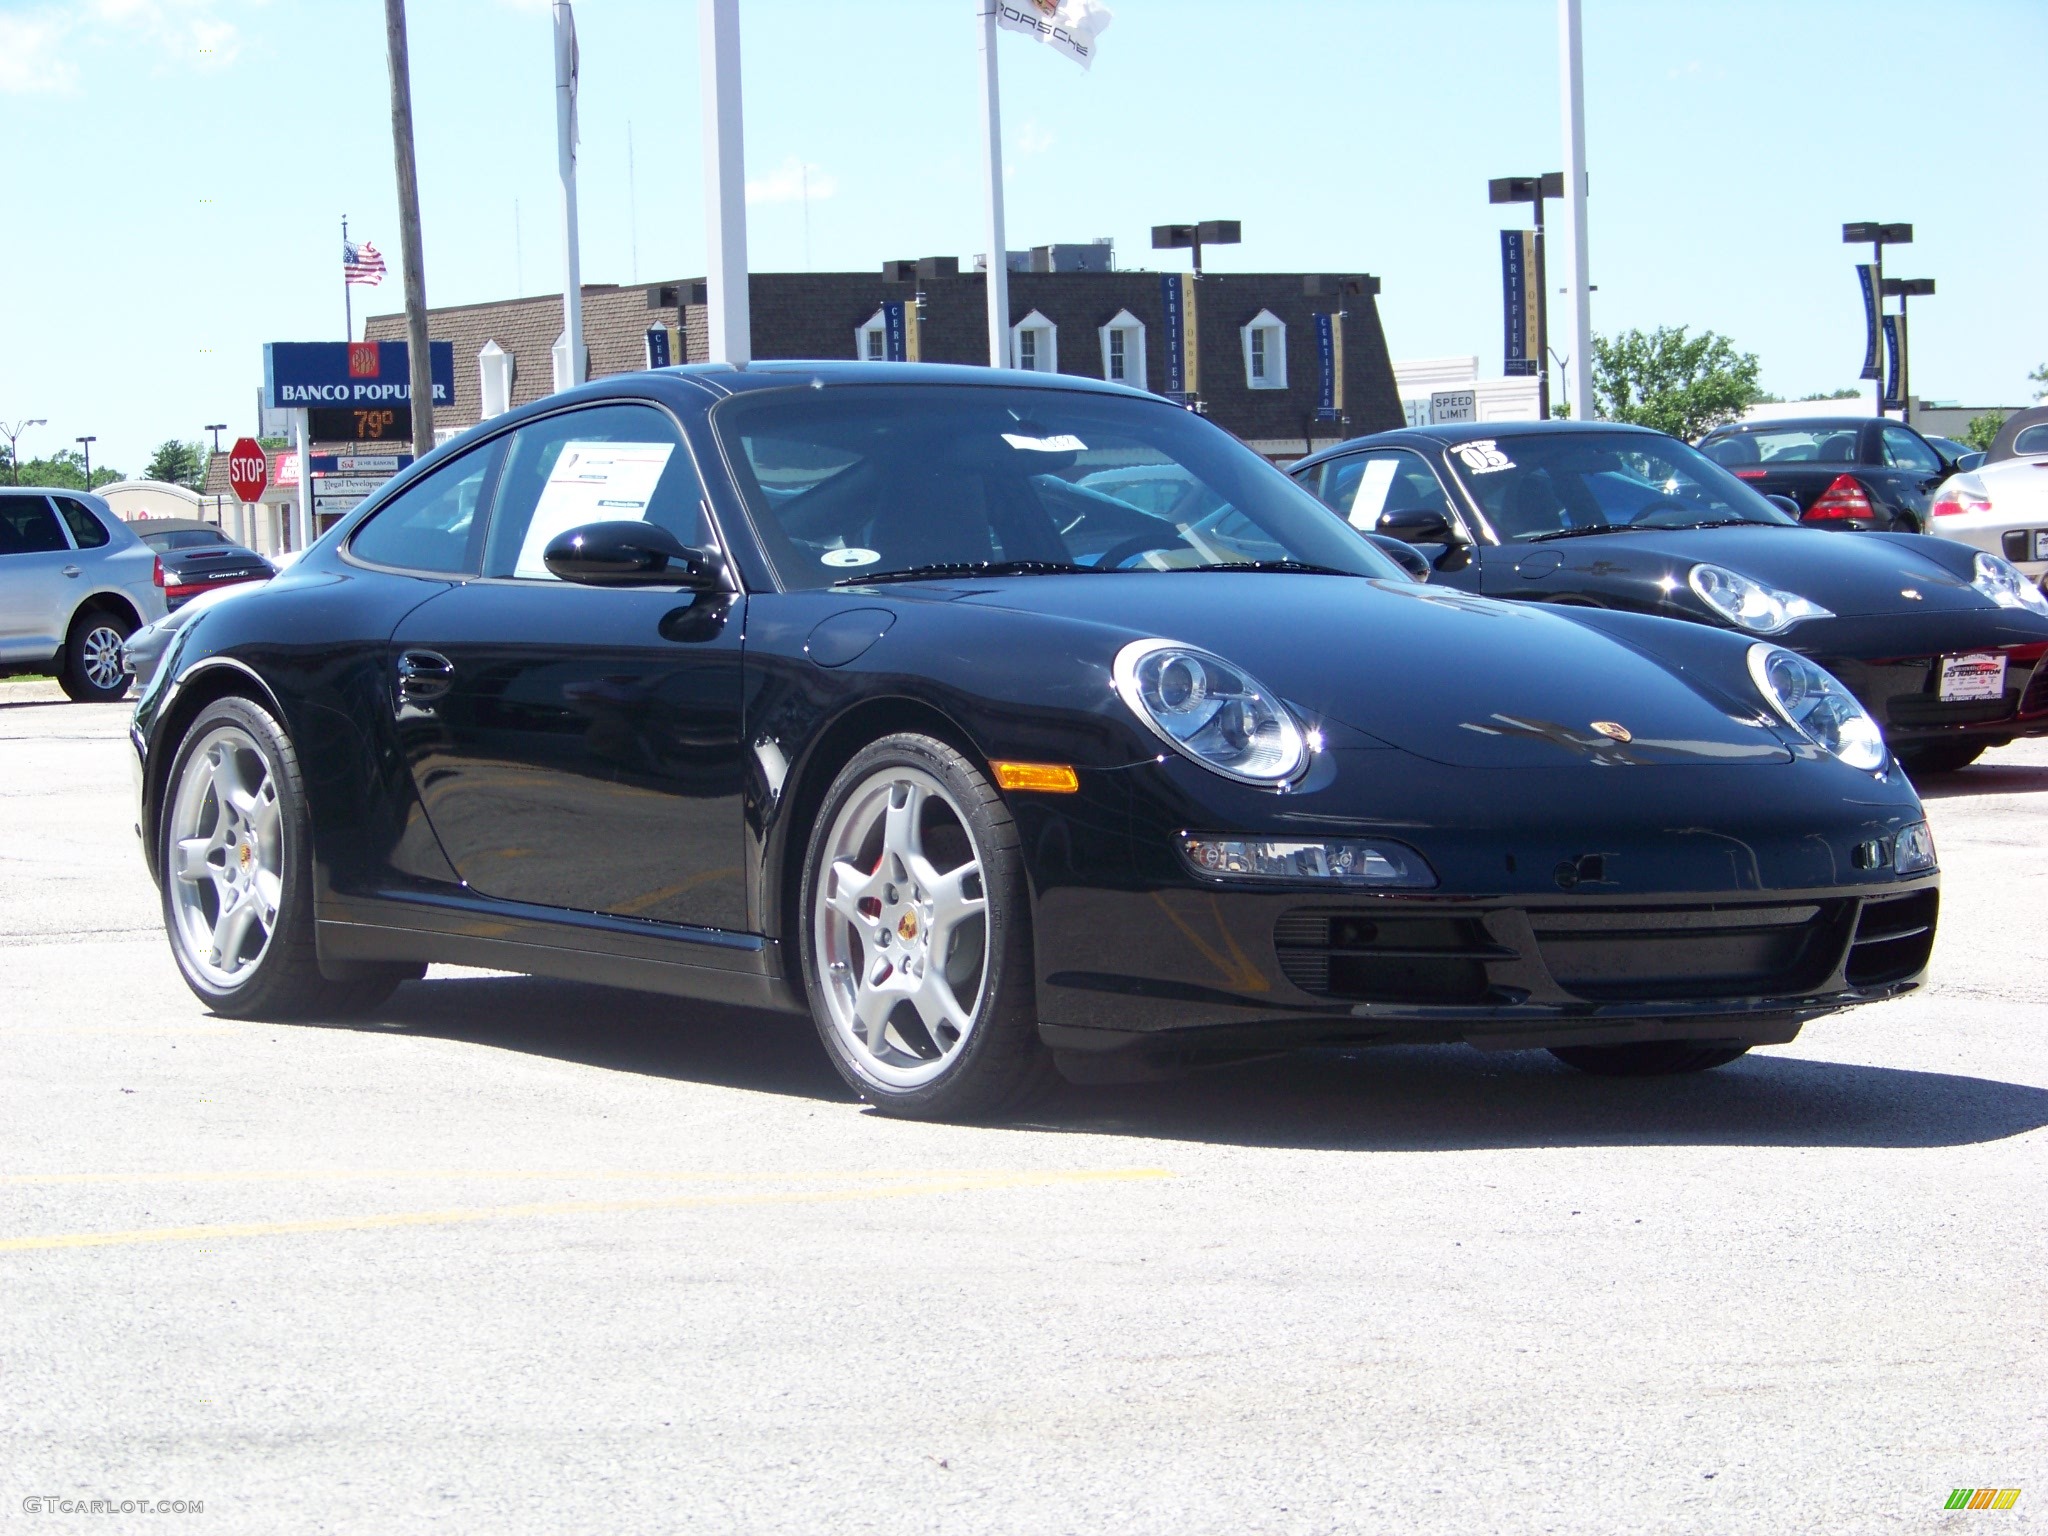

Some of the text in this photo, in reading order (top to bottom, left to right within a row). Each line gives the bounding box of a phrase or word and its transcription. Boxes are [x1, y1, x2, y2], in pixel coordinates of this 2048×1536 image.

[1508, 235, 1519, 357] CERTIFIED
[1528, 290, 1536, 343] Owned
[1168, 277, 1179, 390] CERTIFIED
[1320, 318, 1330, 407] CERTIFIED
[282, 384, 446, 400] BANCO POPUR
[1435, 396, 1472, 408] SPEED
[1440, 408, 1469, 419] LIMIT
[1460, 446, 1508, 469] 05
[231, 458, 265, 484] STOP
[324, 480, 344, 490] Regal
